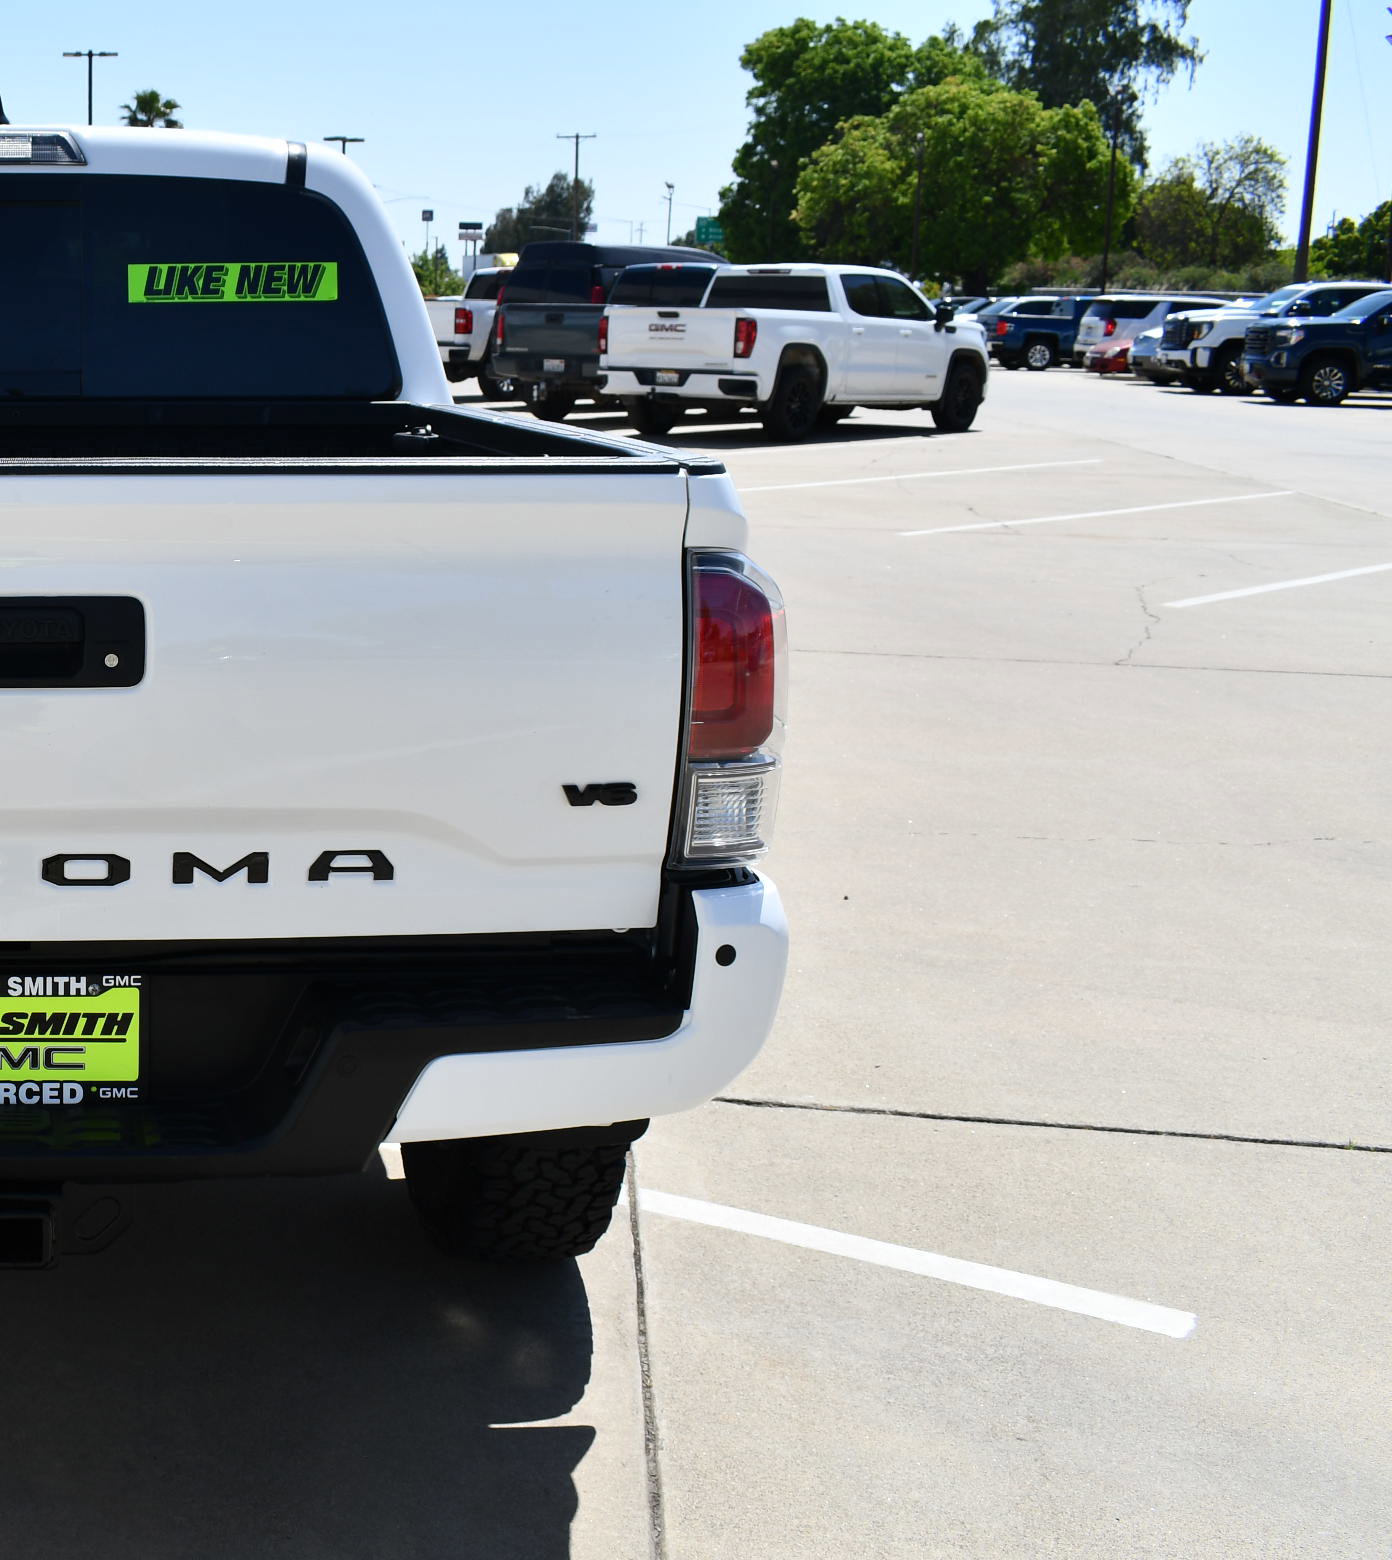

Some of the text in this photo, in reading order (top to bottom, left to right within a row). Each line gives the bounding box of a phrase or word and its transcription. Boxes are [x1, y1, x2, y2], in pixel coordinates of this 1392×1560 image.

[144, 264, 326, 299] LIKE NEW
[648, 323, 686, 333] GMC
[561, 782, 638, 806] V6
[7, 976, 87, 996] SMITH
[102, 975, 142, 987] GMC
[99, 1087, 139, 1099] GMC
